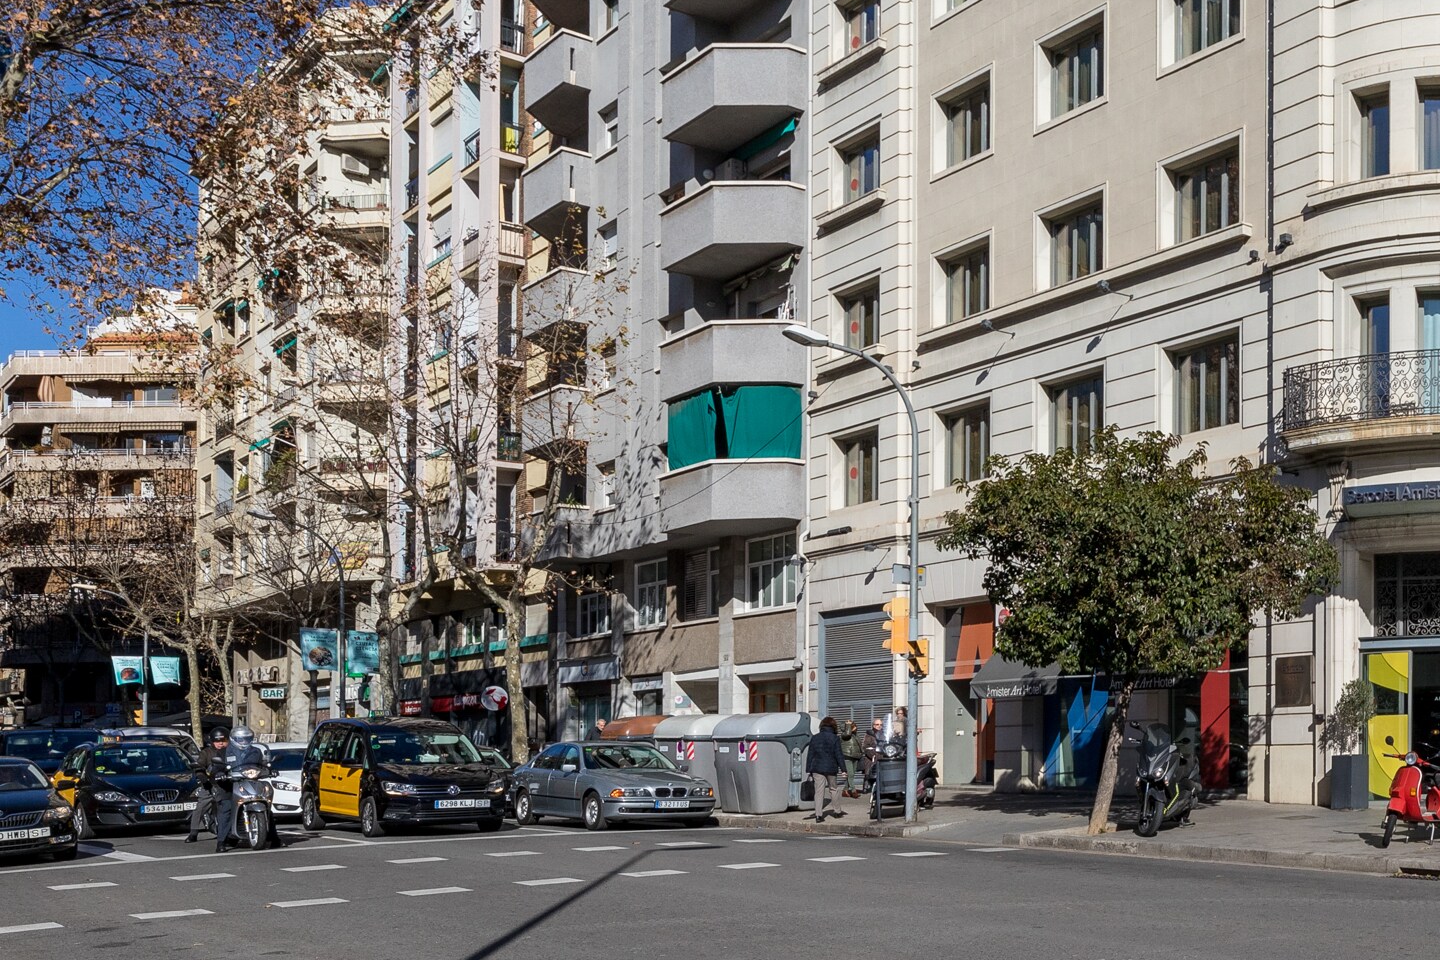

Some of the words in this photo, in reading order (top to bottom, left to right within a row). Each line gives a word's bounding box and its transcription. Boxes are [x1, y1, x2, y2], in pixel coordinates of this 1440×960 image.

[1153, 676, 1176, 688] Hotel
[262, 689, 283, 698] BAR
[1010, 685, 1022, 696] Art
[1022, 683, 1042, 696] Hotel
[7, 830, 26, 839] HWB
[31, 829, 48, 838] SP
